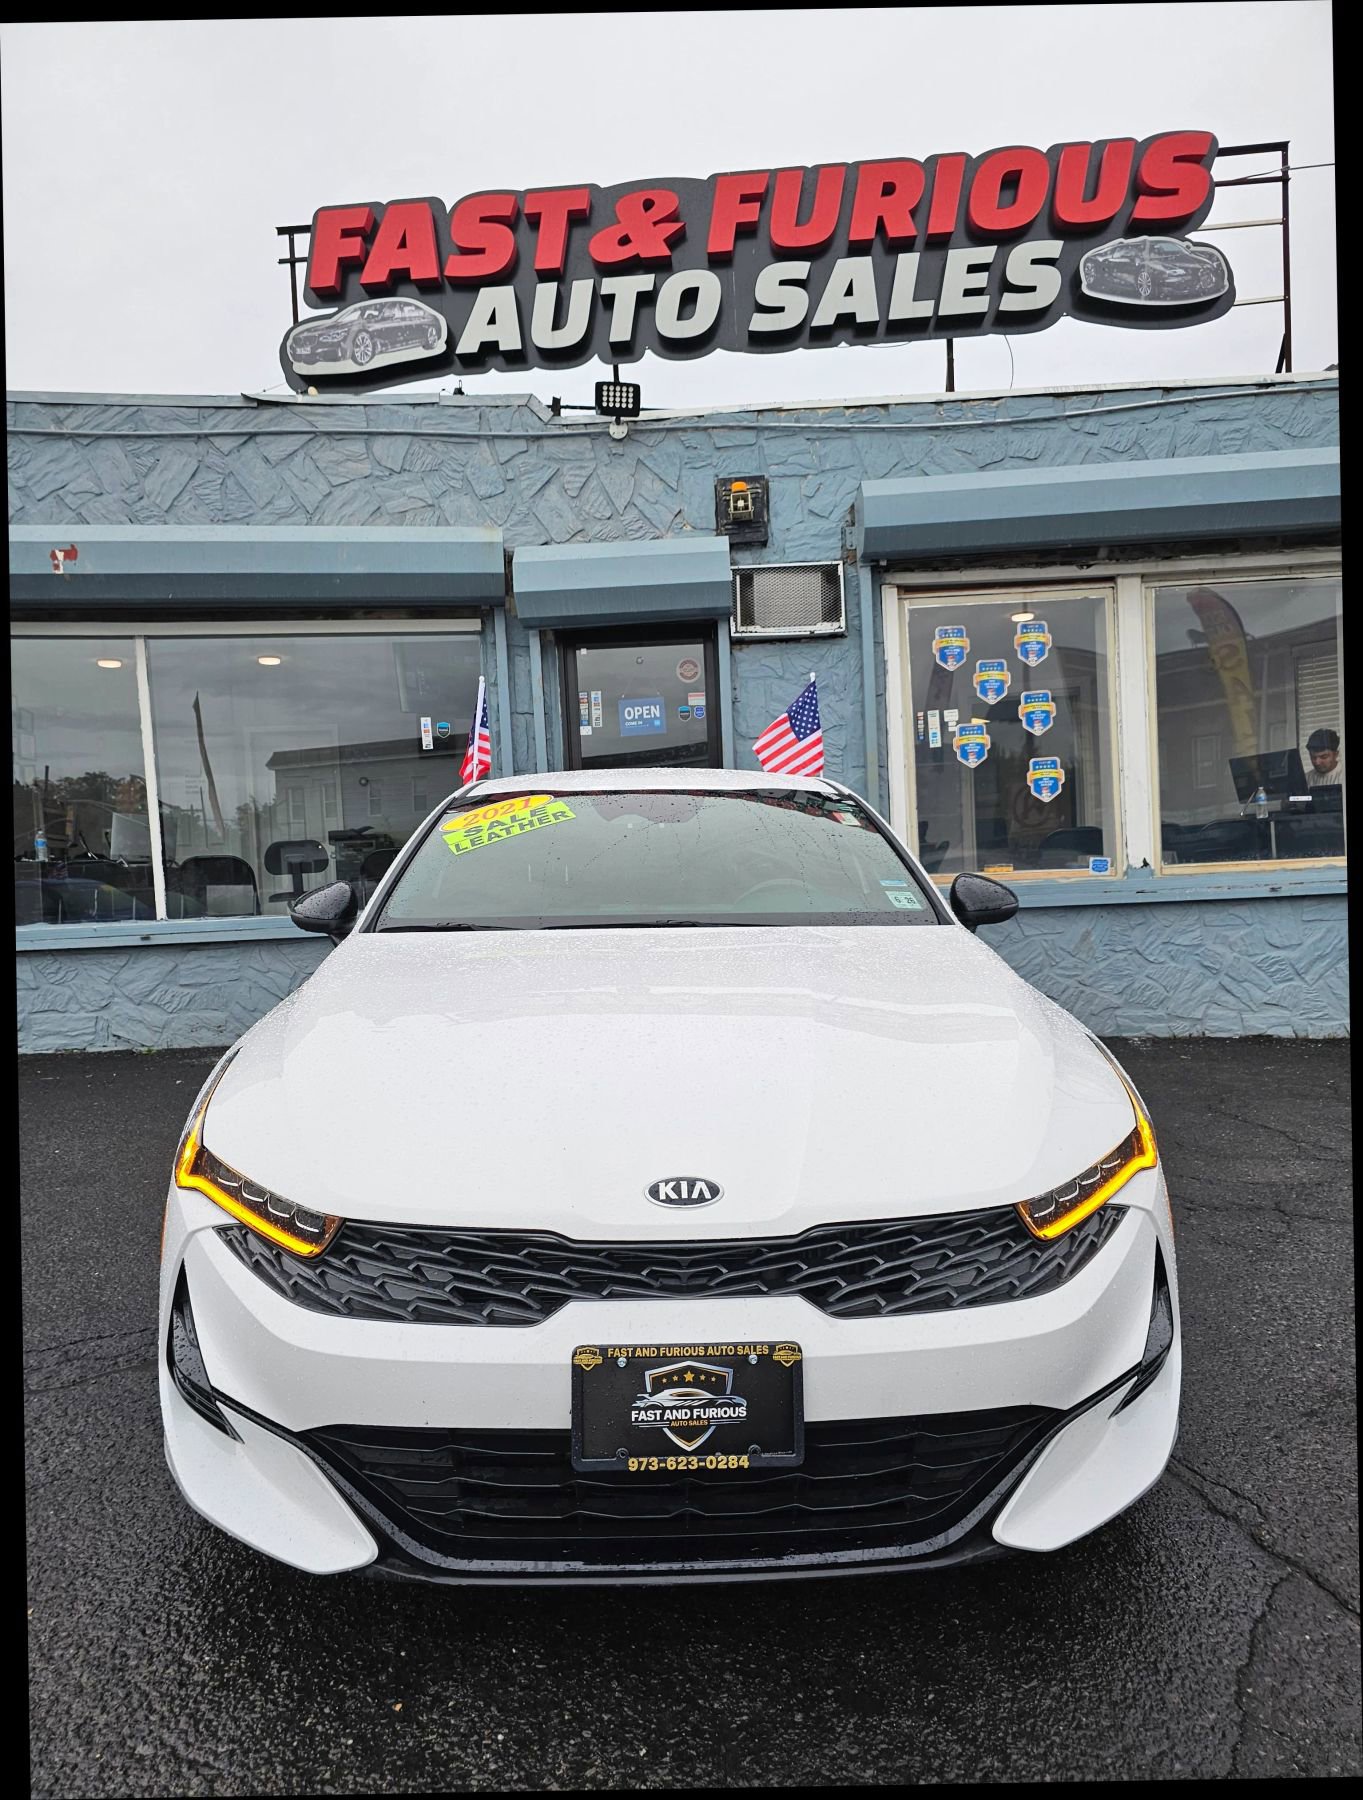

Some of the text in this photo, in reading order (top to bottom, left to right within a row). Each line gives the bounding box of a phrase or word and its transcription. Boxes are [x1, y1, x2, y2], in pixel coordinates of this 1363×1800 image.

[309, 131, 1216, 294] FAST & FURIOUS
[455, 240, 1065, 358] AUTO SALES
[624, 704, 660, 720] OPEN
[463, 797, 532, 828] 2021
[464, 806, 548, 838] SALE
[454, 811, 570, 853] LEATHER
[658, 1180, 712, 1200] KIA
[607, 1344, 769, 1358] FAST AND FURIOUS AUTO SALES
[631, 1406, 747, 1422] FAST AND FURIOUS
[627, 1455, 750, 1472] 973-623-0284
